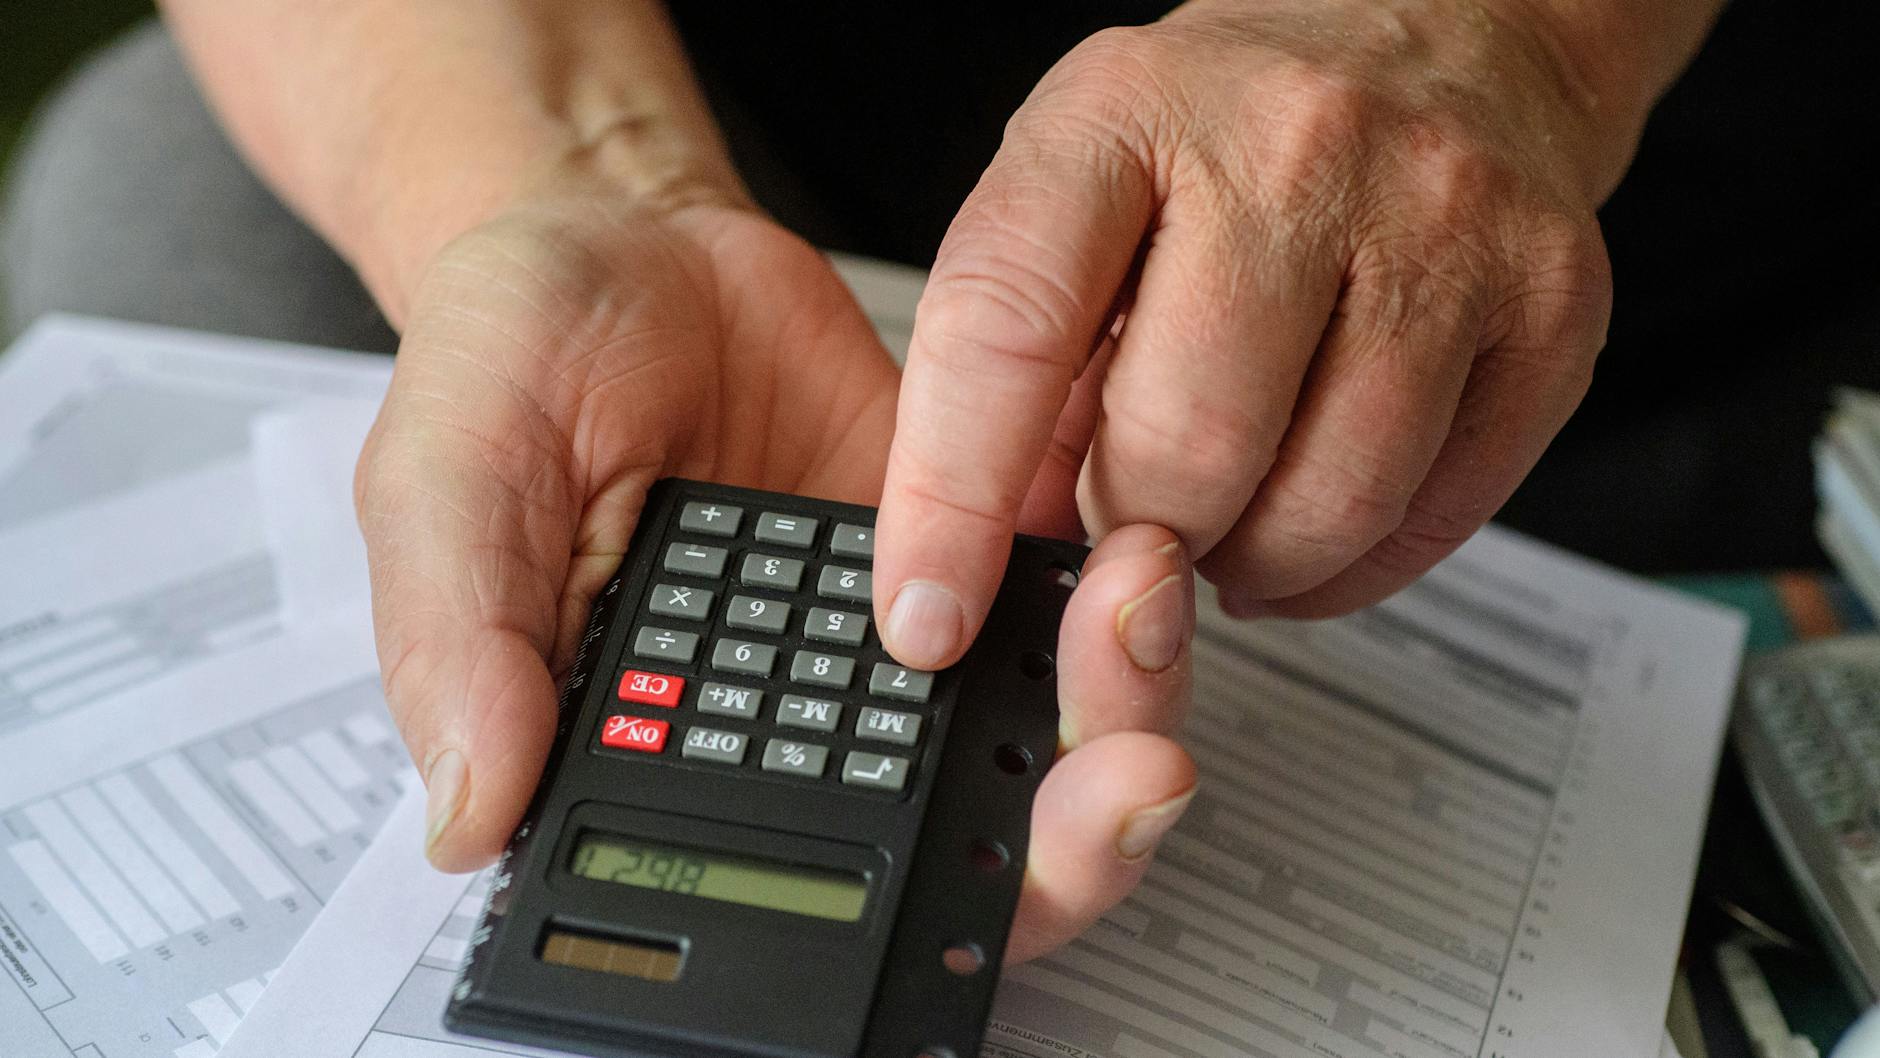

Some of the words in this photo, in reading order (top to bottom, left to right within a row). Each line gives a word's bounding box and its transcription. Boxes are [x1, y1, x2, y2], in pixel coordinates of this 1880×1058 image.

[764, 559, 781, 576] 3
[839, 570, 858, 588] 2
[749, 600, 766, 618] 6
[826, 613, 845, 631] 5
[735, 644, 752, 662] 9
[812, 657, 831, 676] 8
[630, 674, 669, 695] CE
[891, 671, 908, 688] 7
[708, 687, 751, 710] M+
[788, 700, 831, 722] M-
[608, 715, 659, 744] ON/C
[688, 731, 739, 753] OFF
